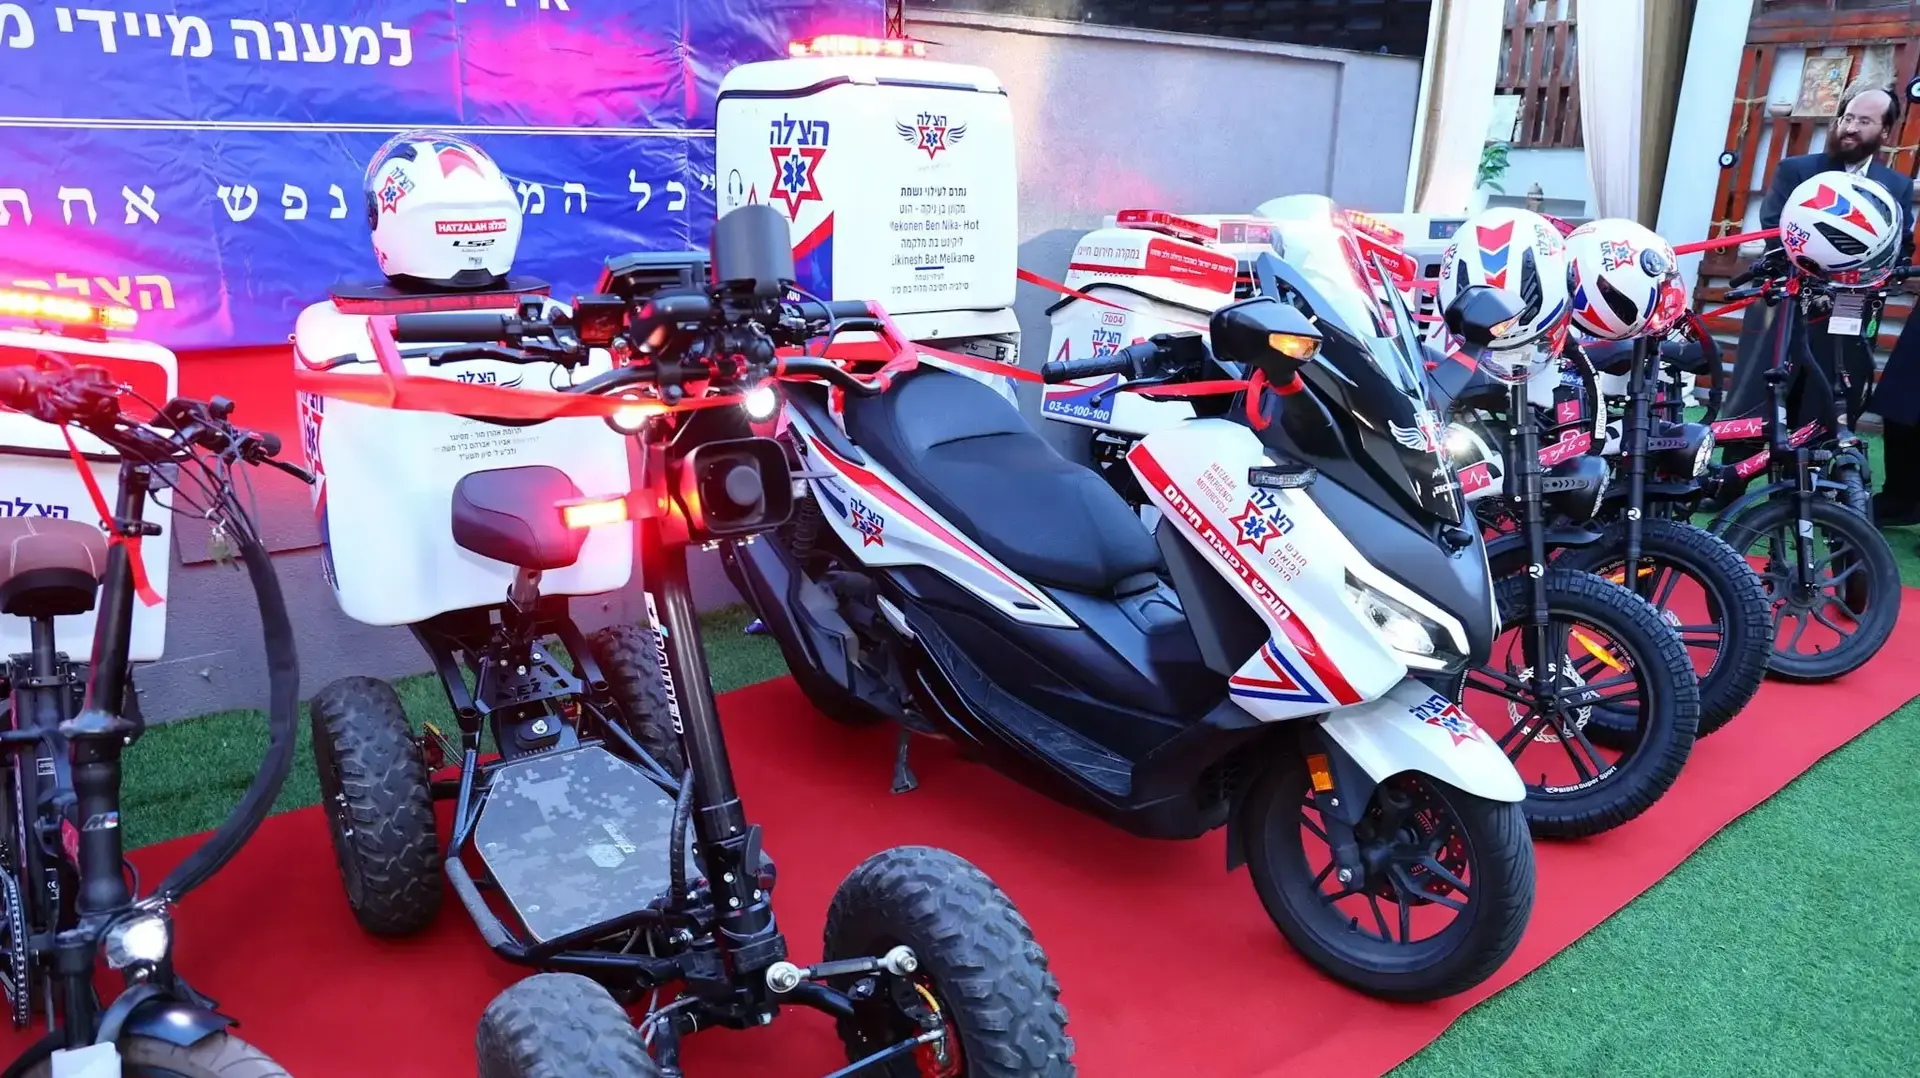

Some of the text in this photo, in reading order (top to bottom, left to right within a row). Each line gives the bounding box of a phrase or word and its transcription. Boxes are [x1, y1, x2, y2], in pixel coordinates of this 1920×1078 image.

[0, 2, 413, 67] למענה מיידי מ
[770, 112, 830, 146] הצלה
[916, 111, 948, 126] הצלה
[216, 183, 349, 222] נפש
[900, 186, 967, 197] נתרם לעילוי נשמת
[438, 221, 488, 234] HATZALAH
[925, 220, 940, 231] Ben
[963, 219, 979, 230] Hot
[1786, 221, 1811, 240] הצלה
[453, 239, 495, 248] LS2
[925, 254, 938, 265] Bat
[1104, 314, 1123, 324] 7004
[1092, 327, 1122, 344] הצלה
[1049, 400, 1110, 420] 03-5-100-100
[1203, 470, 1235, 503] EMERGENCY
[1210, 462, 1238, 490] HATZALAH
[1195, 477, 1229, 515] MOTORCYCLE
[850, 497, 885, 528] הצלה
[1250, 487, 1295, 535] הצלה
[1163, 484, 1291, 620] חובש רפואת חירום
[1274, 548, 1301, 576] רפואת
[1284, 542, 1308, 567] חובש
[1268, 557, 1292, 582] חירום
[1408, 694, 1450, 721] הצלה
[1578, 777, 1599, 789] Super
[1599, 765, 1618, 781] Sport
